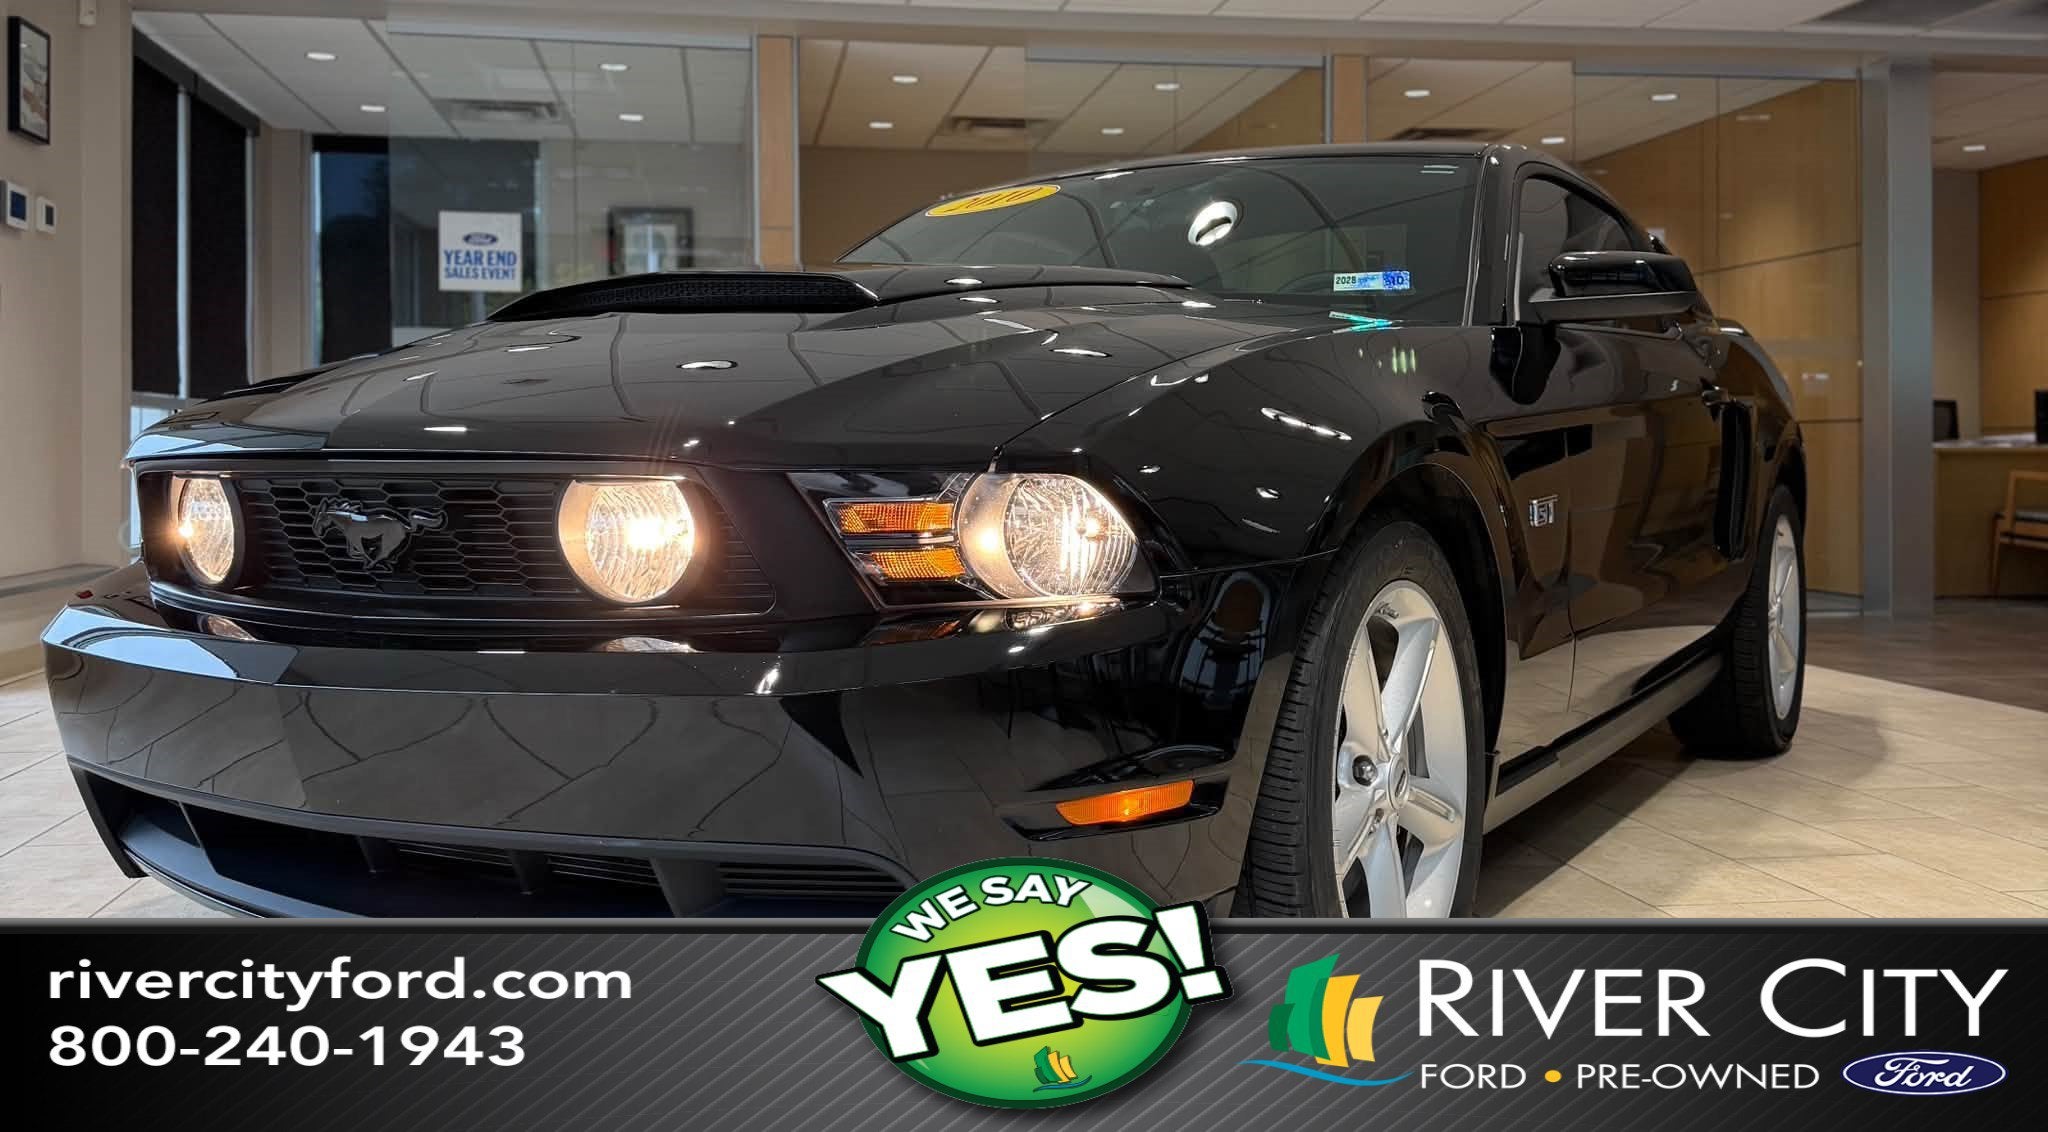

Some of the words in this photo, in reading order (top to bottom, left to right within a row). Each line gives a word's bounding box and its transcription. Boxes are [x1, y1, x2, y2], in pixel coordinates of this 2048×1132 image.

[443, 250, 484, 266] YEAR
[487, 250, 517, 267] END
[444, 267, 480, 279] SALES
[481, 267, 516, 280] EVENT
